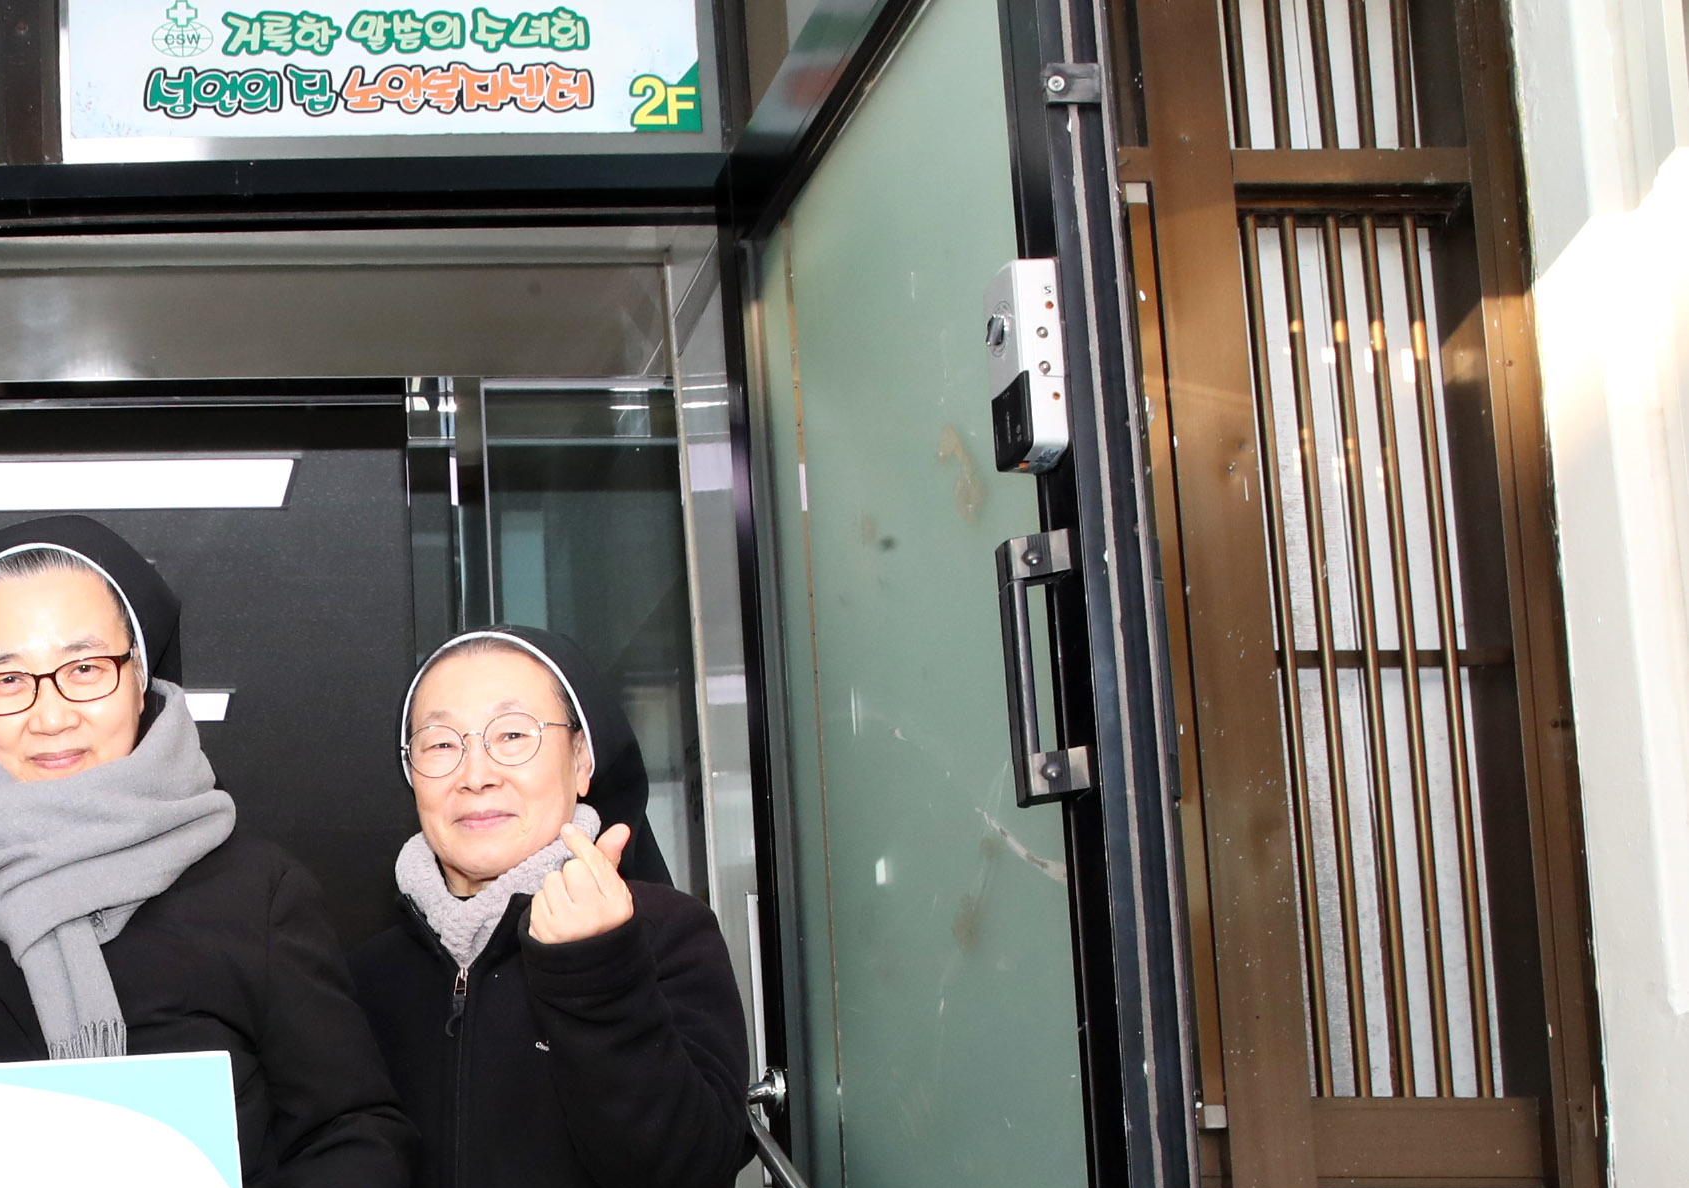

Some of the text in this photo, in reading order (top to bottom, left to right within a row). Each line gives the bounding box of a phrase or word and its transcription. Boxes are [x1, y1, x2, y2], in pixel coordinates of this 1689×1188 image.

[164, 33, 201, 46] CSW
[222, 7, 590, 56] 거룩한 말씀의 수녀회
[144, 66, 283, 118] 성언의
[284, 63, 339, 117] 집
[629, 74, 696, 126] 2F
